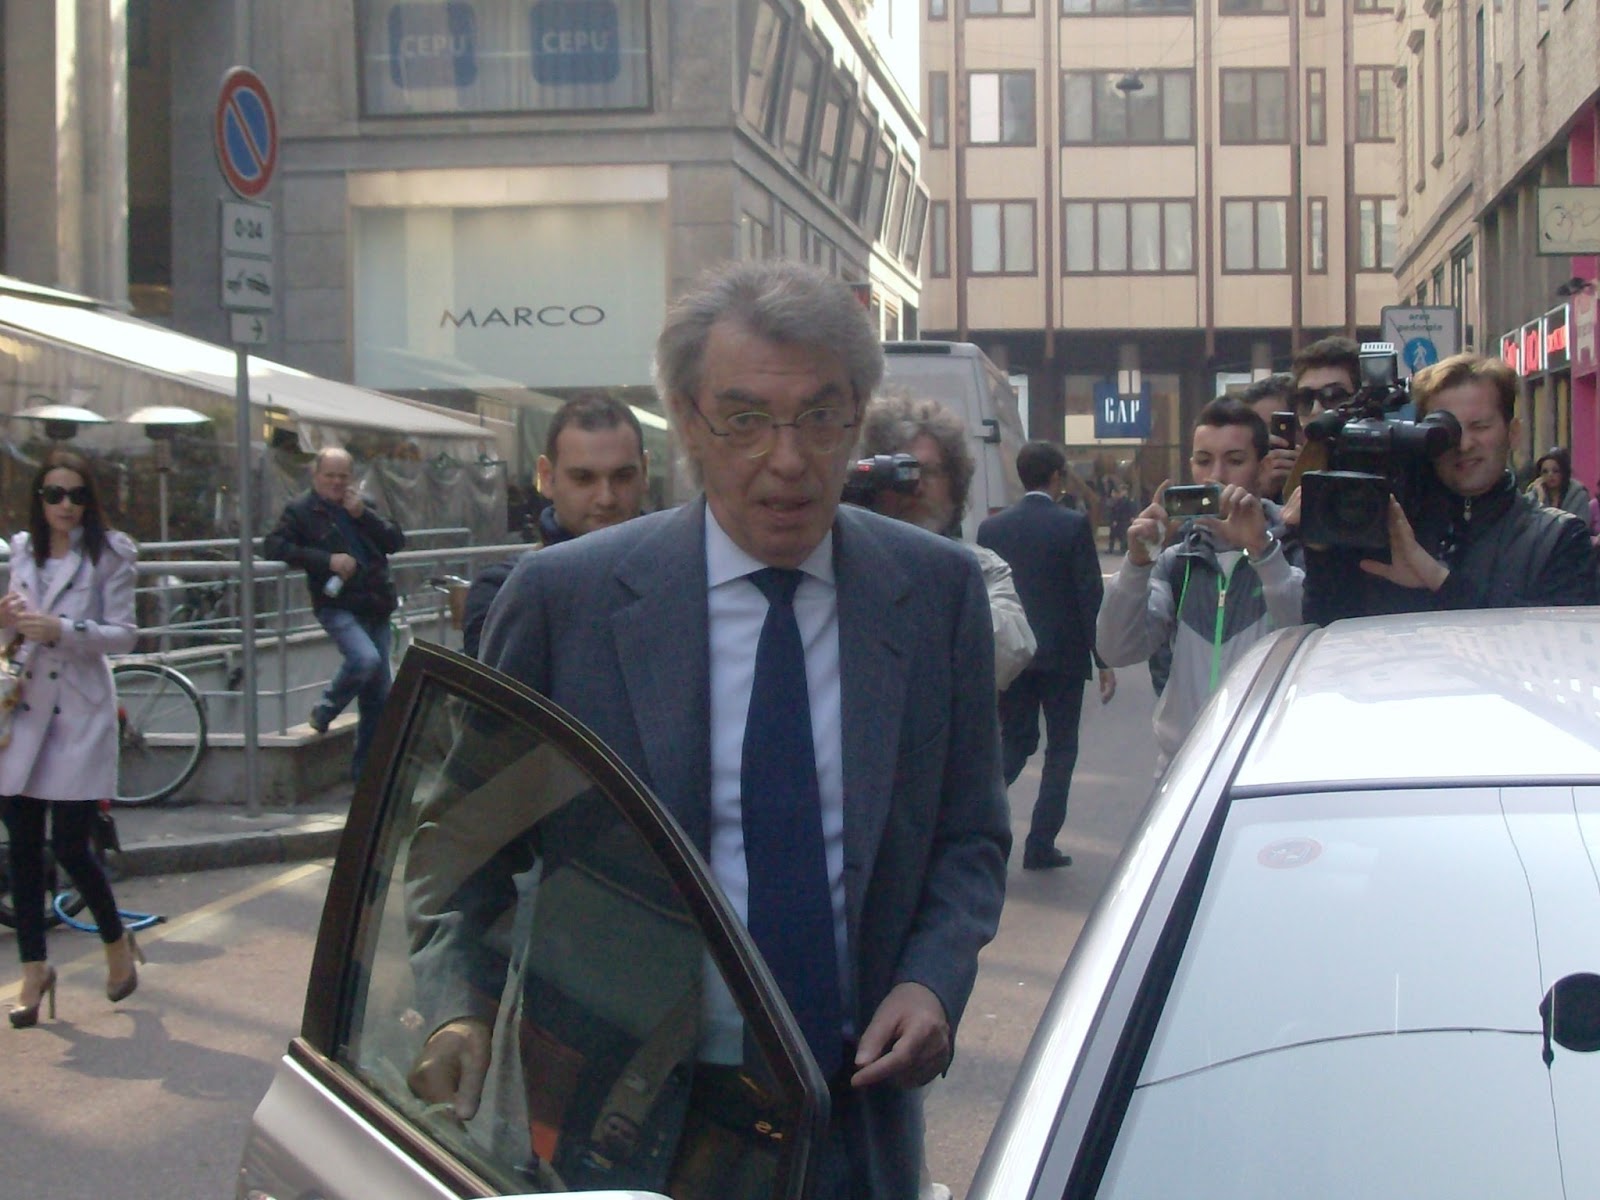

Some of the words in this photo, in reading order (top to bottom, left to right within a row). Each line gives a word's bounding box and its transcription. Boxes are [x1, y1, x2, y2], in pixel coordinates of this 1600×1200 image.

[403, 34, 466, 57] CEPU
[542, 31, 608, 50] CEPU
[440, 305, 605, 328] MARCO
[1105, 397, 1140, 423] GAP
